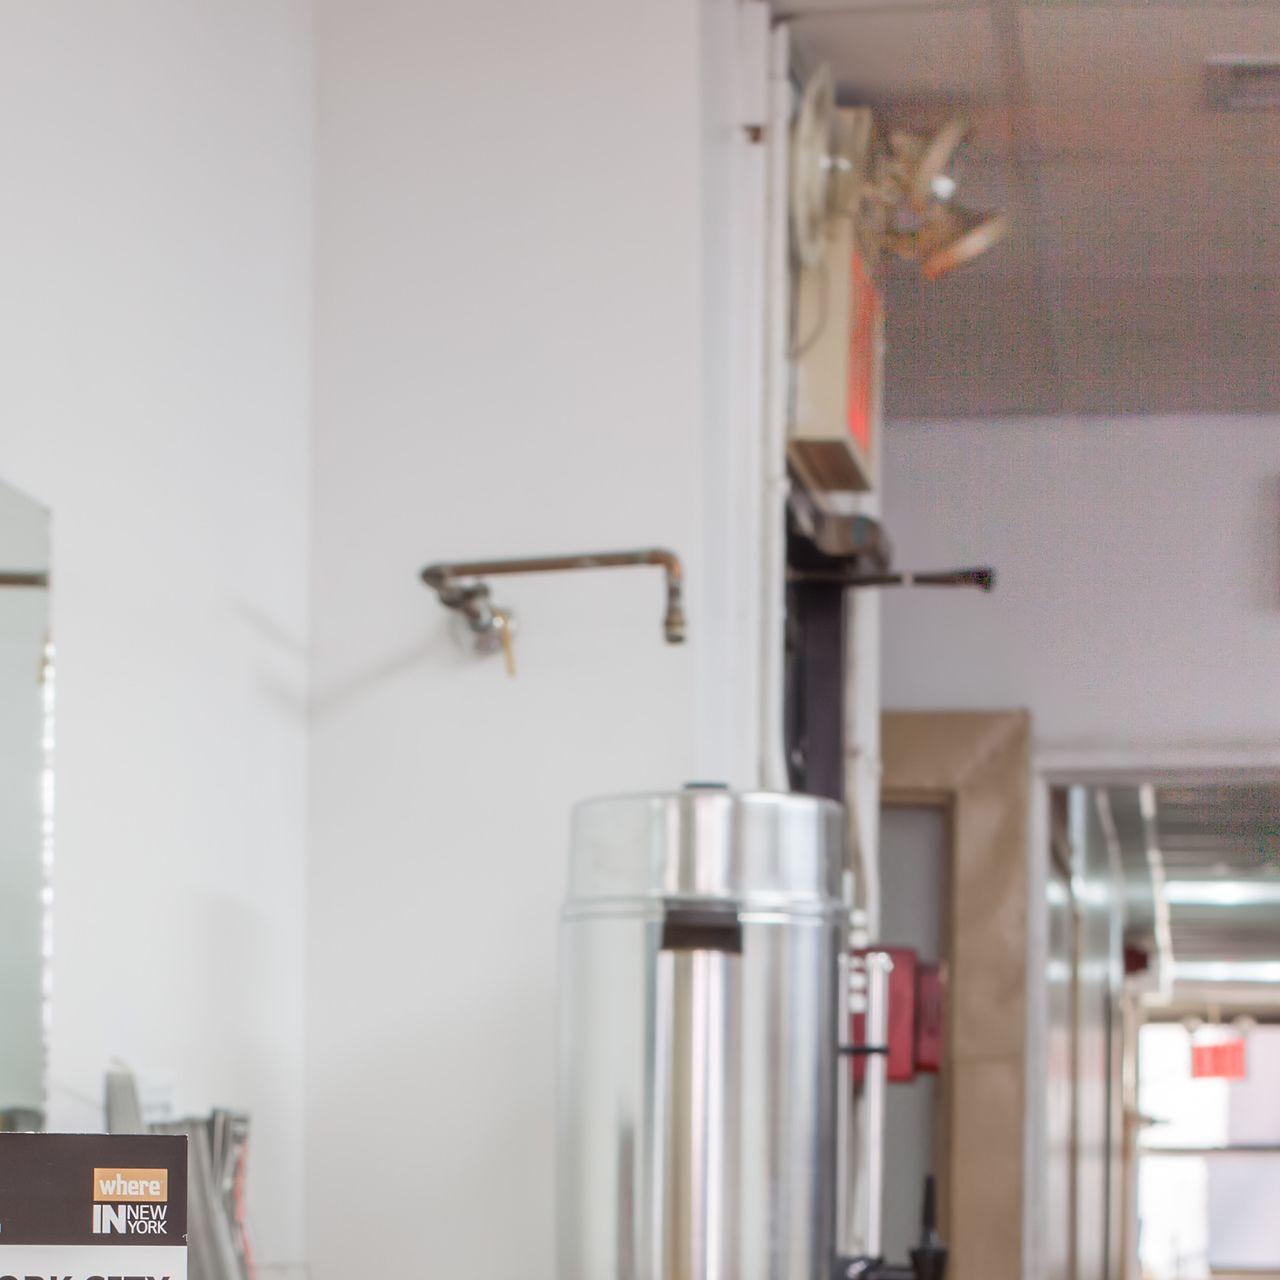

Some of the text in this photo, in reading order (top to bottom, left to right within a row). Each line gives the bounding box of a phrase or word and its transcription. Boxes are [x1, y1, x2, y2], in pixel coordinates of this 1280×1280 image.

[100, 1173, 160, 1196] where
[127, 1205, 167, 1220] NEW
[127, 1220, 167, 1234] YORK
